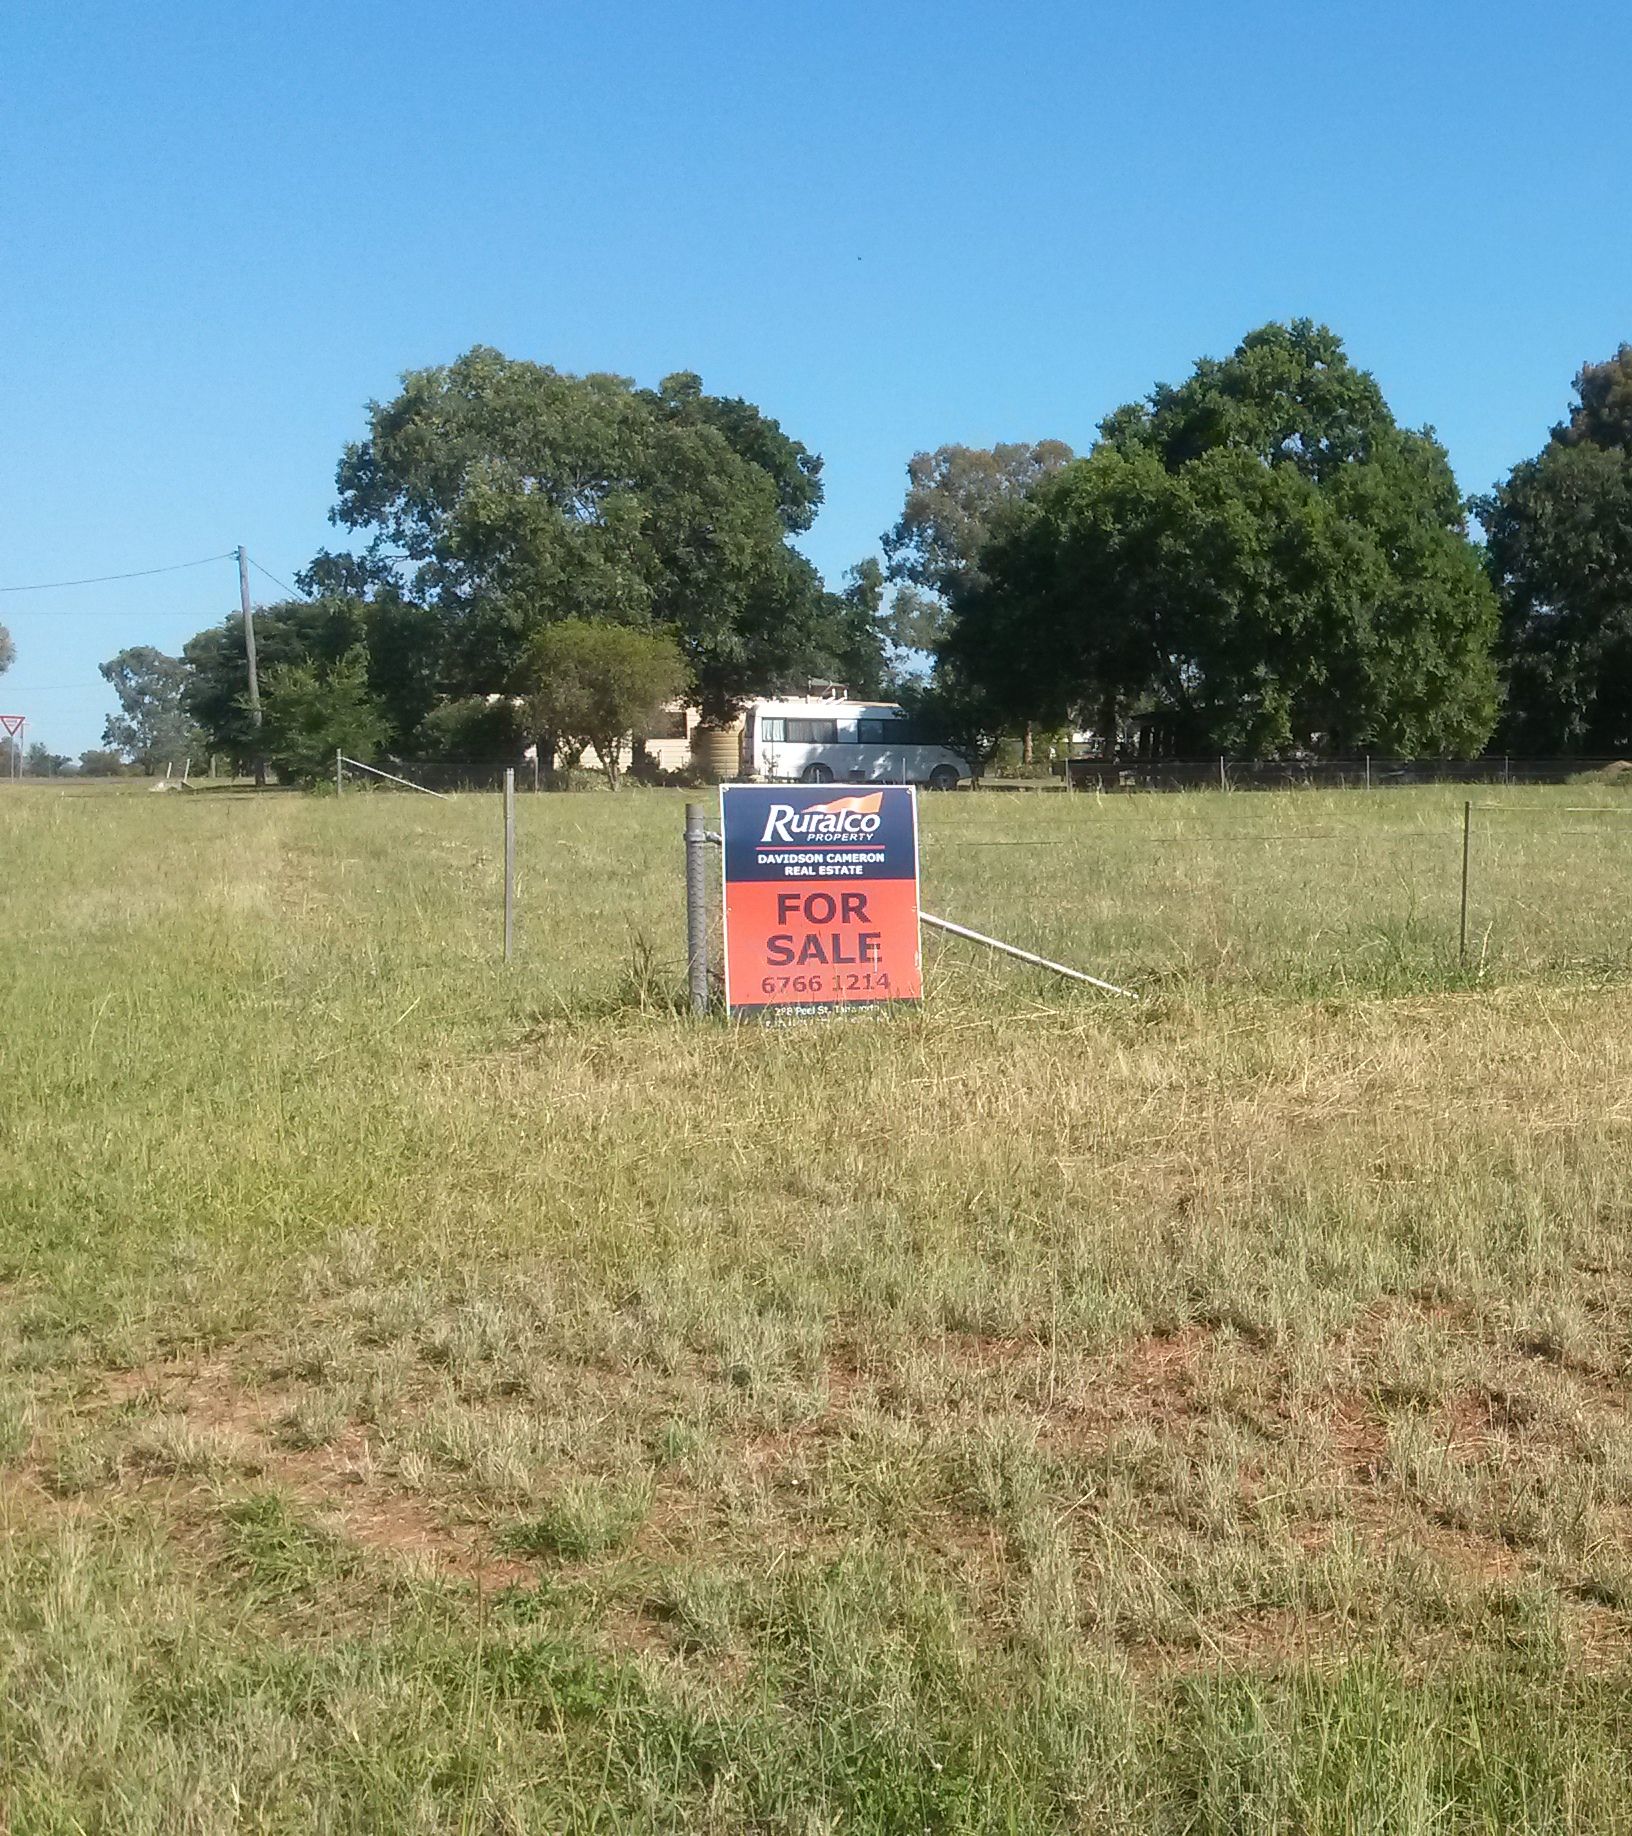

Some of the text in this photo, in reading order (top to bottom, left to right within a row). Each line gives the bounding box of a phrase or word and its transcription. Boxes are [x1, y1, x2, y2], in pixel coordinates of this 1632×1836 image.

[760, 804, 881, 842] Ruralco
[807, 833, 874, 842] PROPERTY
[757, 852, 885, 864] DAVIDSON CAMERON
[785, 865, 863, 876] REAL ESTATE
[777, 892, 872, 926] FOR
[766, 931, 883, 967] SALE
[761, 973, 890, 994] 6766 1214
